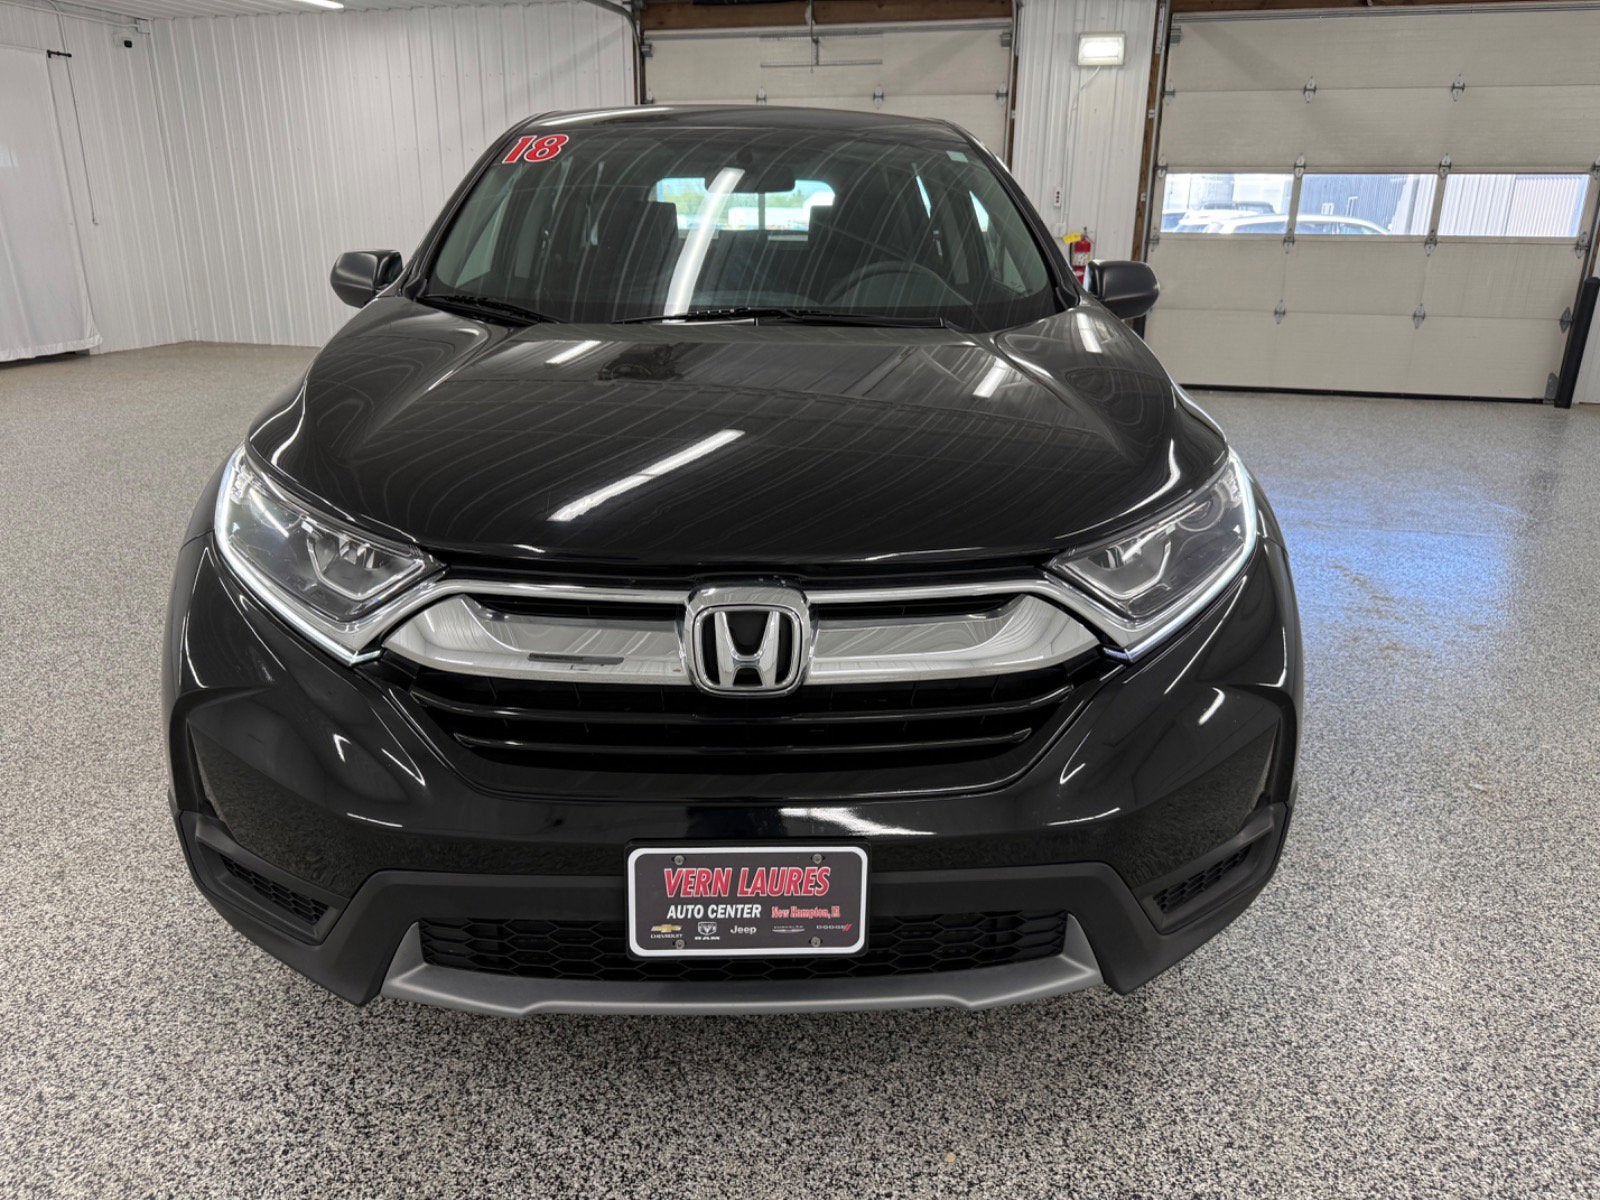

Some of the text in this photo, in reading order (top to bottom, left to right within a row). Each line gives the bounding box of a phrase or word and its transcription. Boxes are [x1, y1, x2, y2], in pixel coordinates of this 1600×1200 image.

[502, 134, 569, 164] 18
[664, 866, 831, 897] VERN LAURES
[667, 904, 762, 919] AUTO CENTER
[771, 906, 789, 918] New
[730, 925, 757, 935] Jeep
